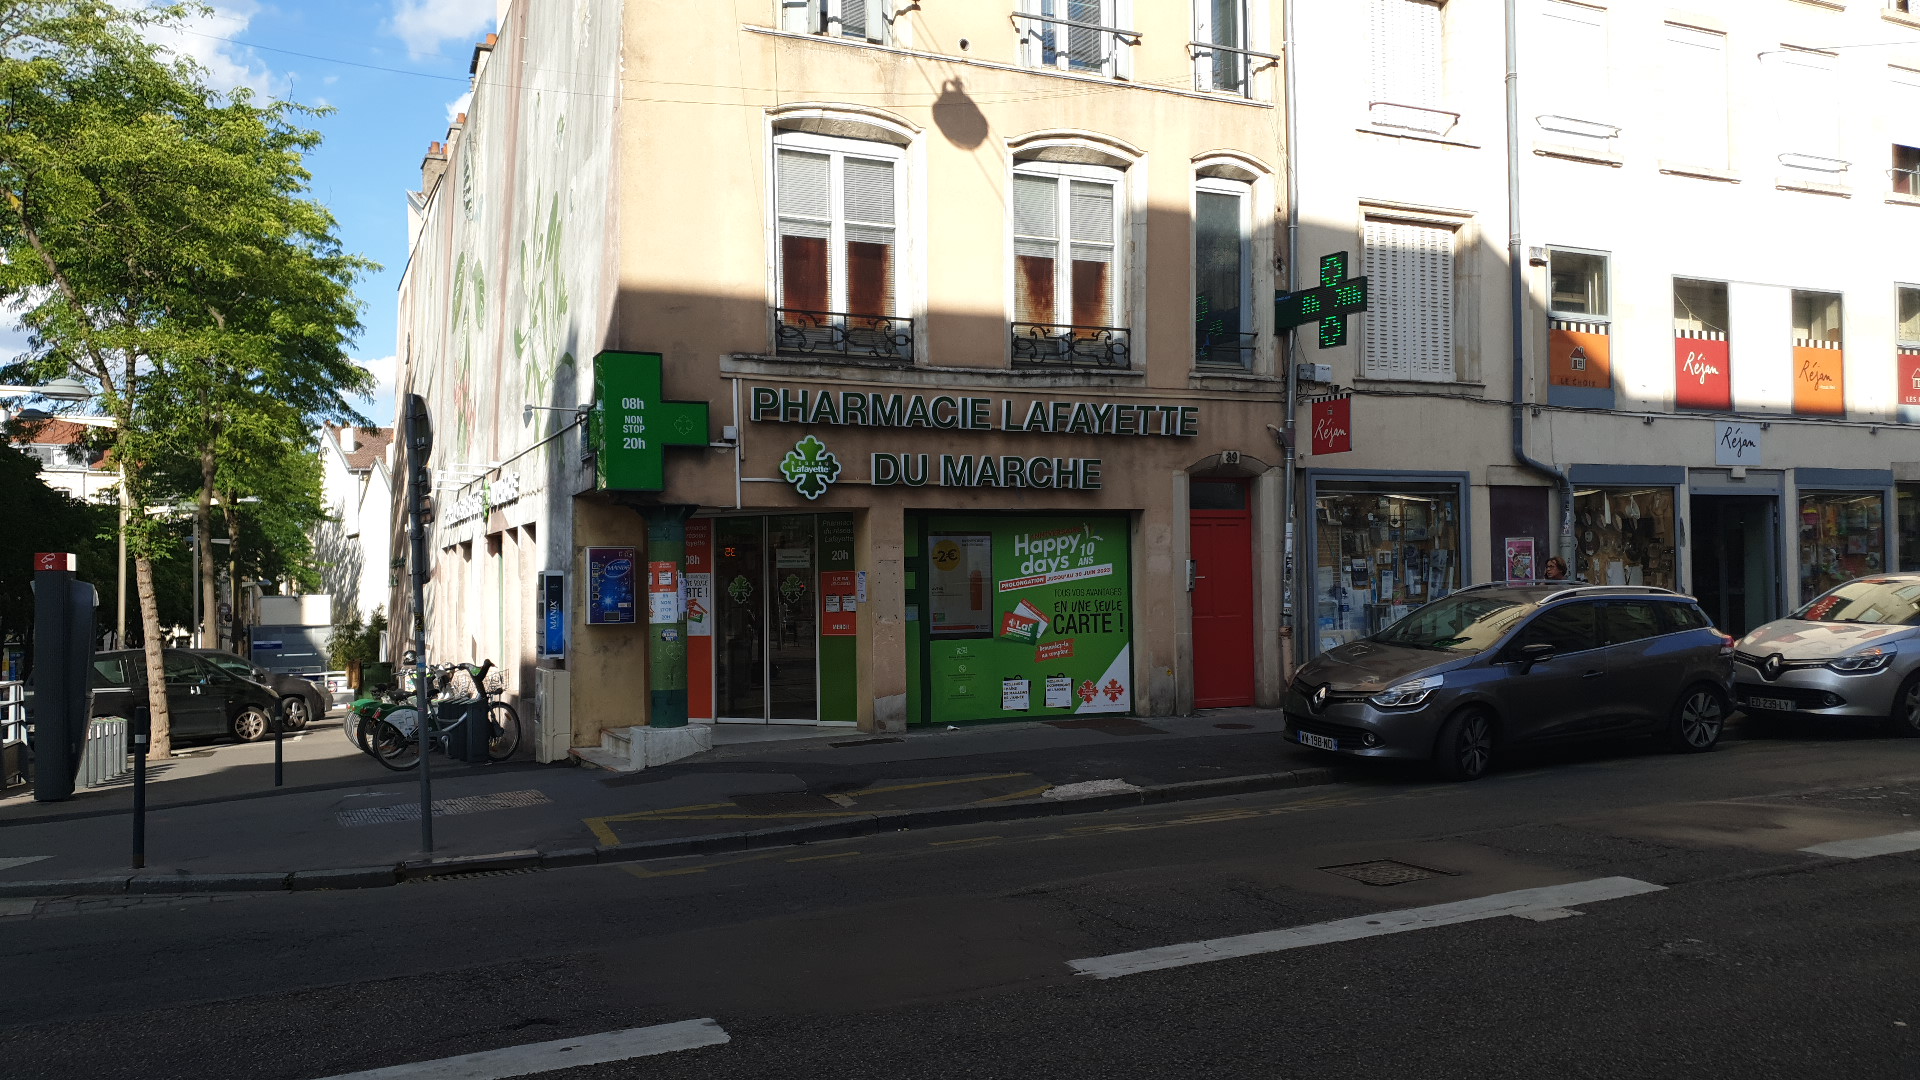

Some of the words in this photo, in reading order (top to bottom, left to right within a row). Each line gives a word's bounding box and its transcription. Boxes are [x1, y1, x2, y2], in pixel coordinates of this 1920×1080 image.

[1683, 351, 1719, 385] Réjan
[1798, 359, 1833, 391] Réjan
[1560, 378, 1569, 386] LE
[1572, 378, 1596, 388] CHOIX
[621, 398, 645, 410] 08h
[751, 386, 992, 430] PHARMACIE
[1001, 399, 1199, 437] LAFAYETTE
[624, 415, 643, 424] NON
[622, 425, 645, 434] STOP
[1314, 418, 1347, 448] Réjan
[623, 437, 646, 450] 20h
[1720, 426, 1756, 458] Réjan
[791, 465, 829, 473] Lafayette
[870, 452, 929, 487] DU
[940, 454, 1103, 490] MARCHE
[1014, 533, 1081, 557] Happy
[1080, 542, 1095, 556] 10
[831, 549, 849, 561] 20h
[1077, 556, 1094, 567] ANS
[1020, 555, 1070, 575] days
[1001, 577, 1045, 589] PROLONGATION
[686, 587, 702, 598] RTE
[1054, 600, 1068, 612] EN
[1071, 600, 1092, 612] UNE
[1094, 599, 1123, 612] SEULE
[550, 599, 558, 630] MANIX
[1053, 613, 1113, 634] CARTE
[1119, 613, 1124, 633] !
